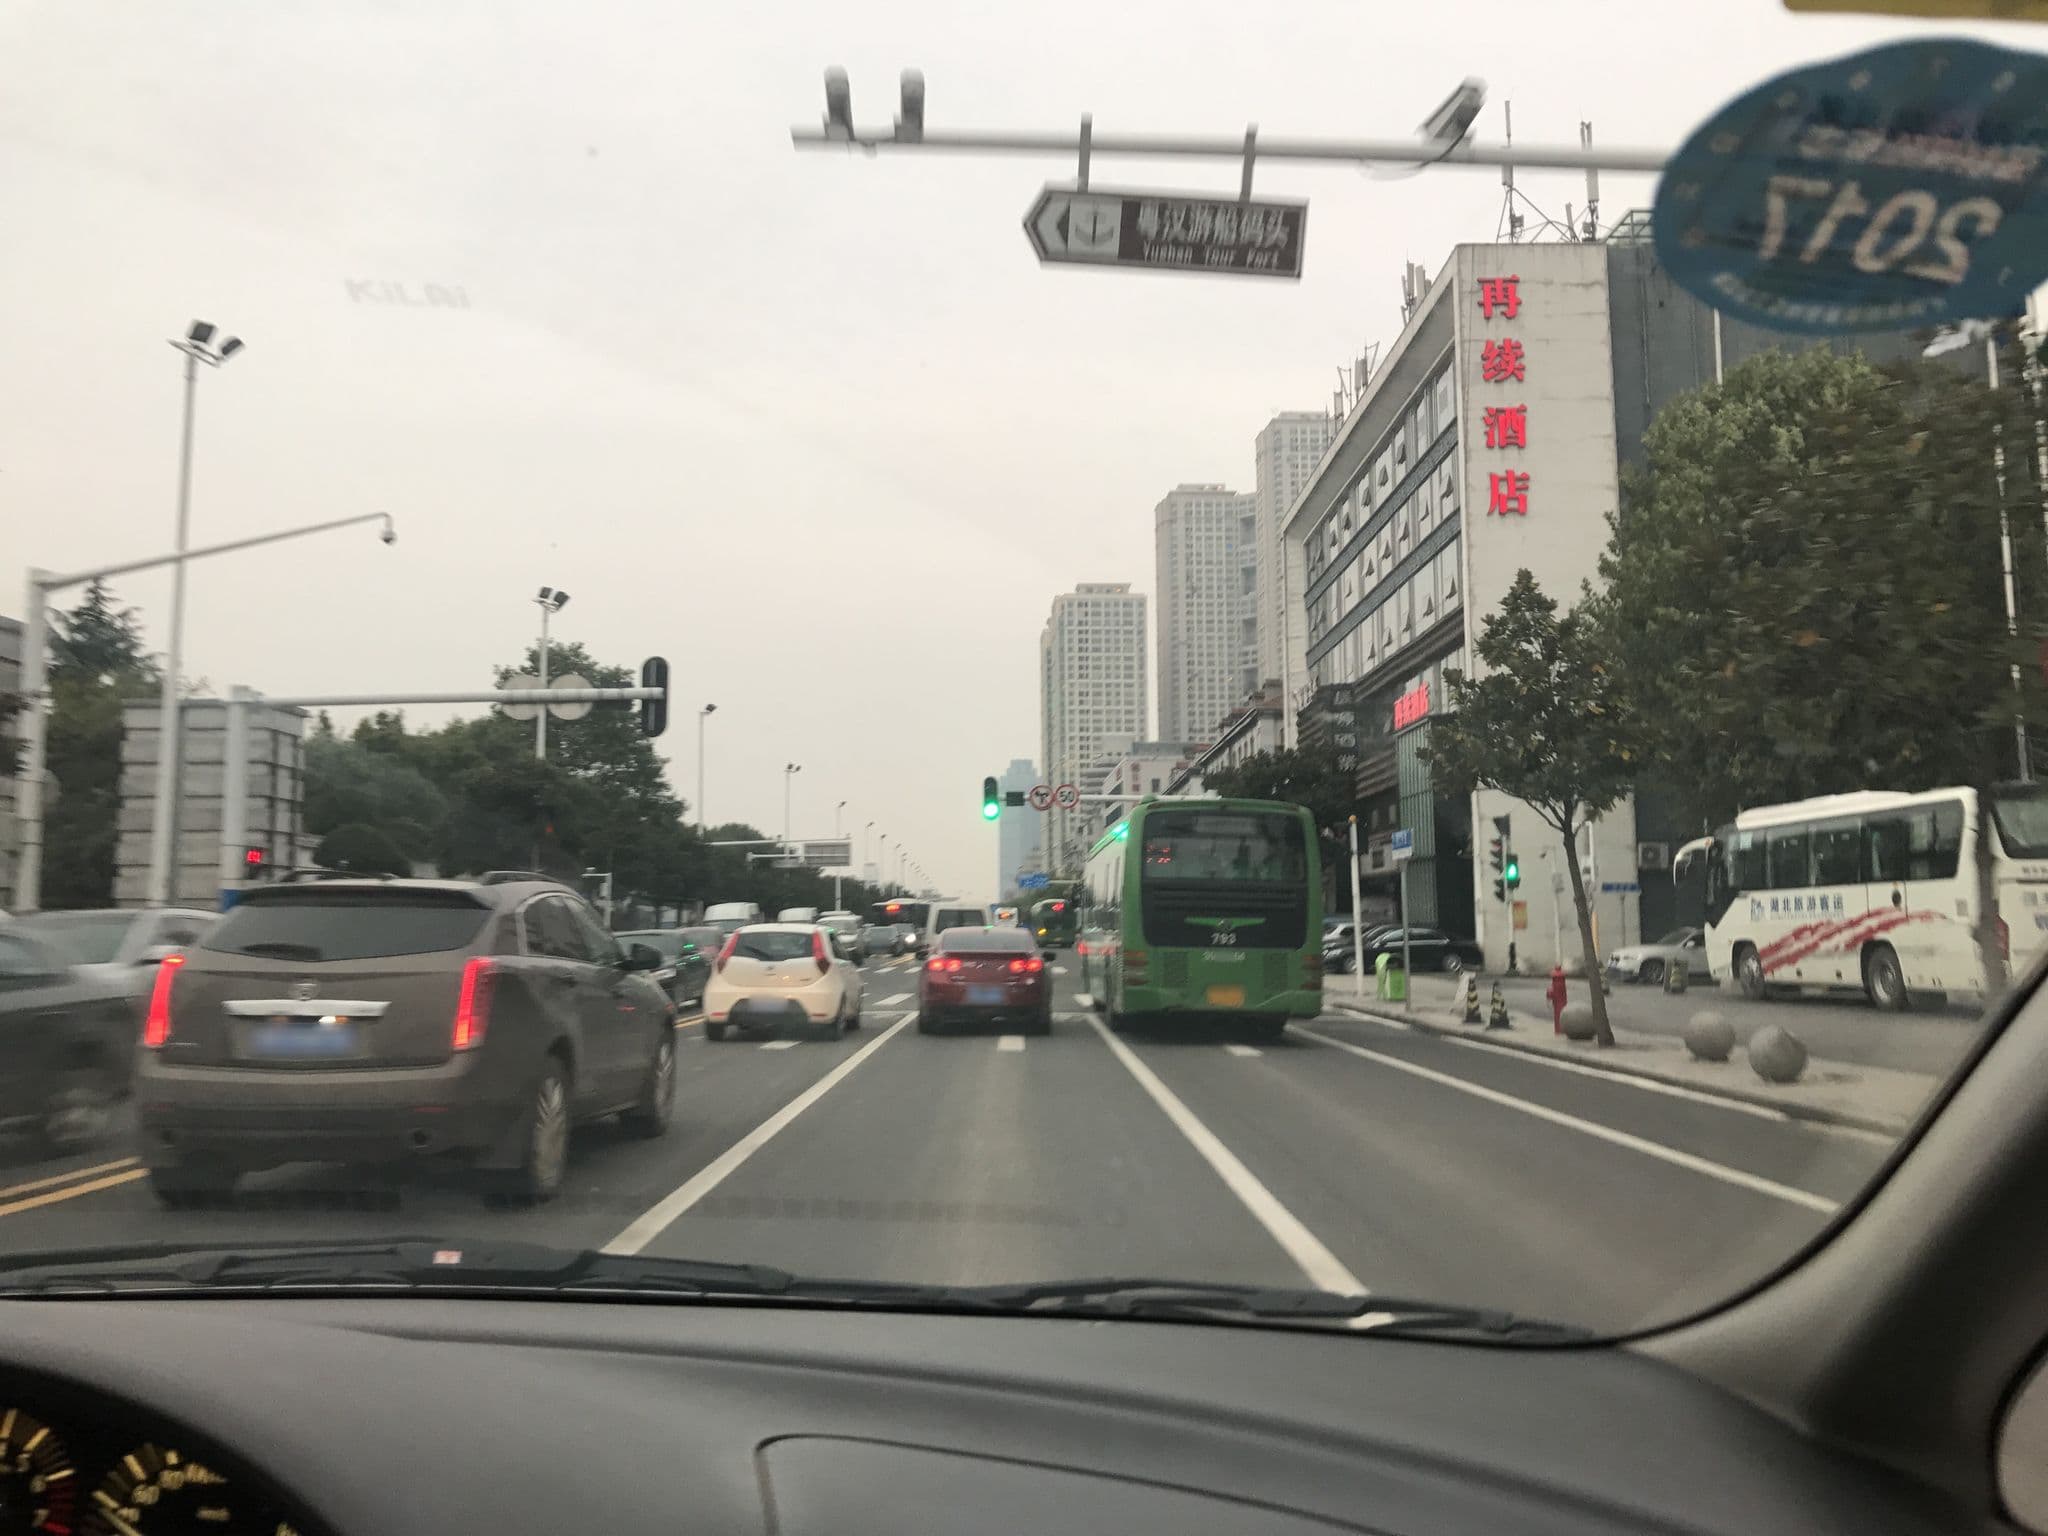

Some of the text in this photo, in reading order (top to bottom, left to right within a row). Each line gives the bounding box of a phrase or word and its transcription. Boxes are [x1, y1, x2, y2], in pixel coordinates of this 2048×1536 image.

[1477, 274, 1530, 516] 再续酒店
[1060, 791, 1075, 803] 50
